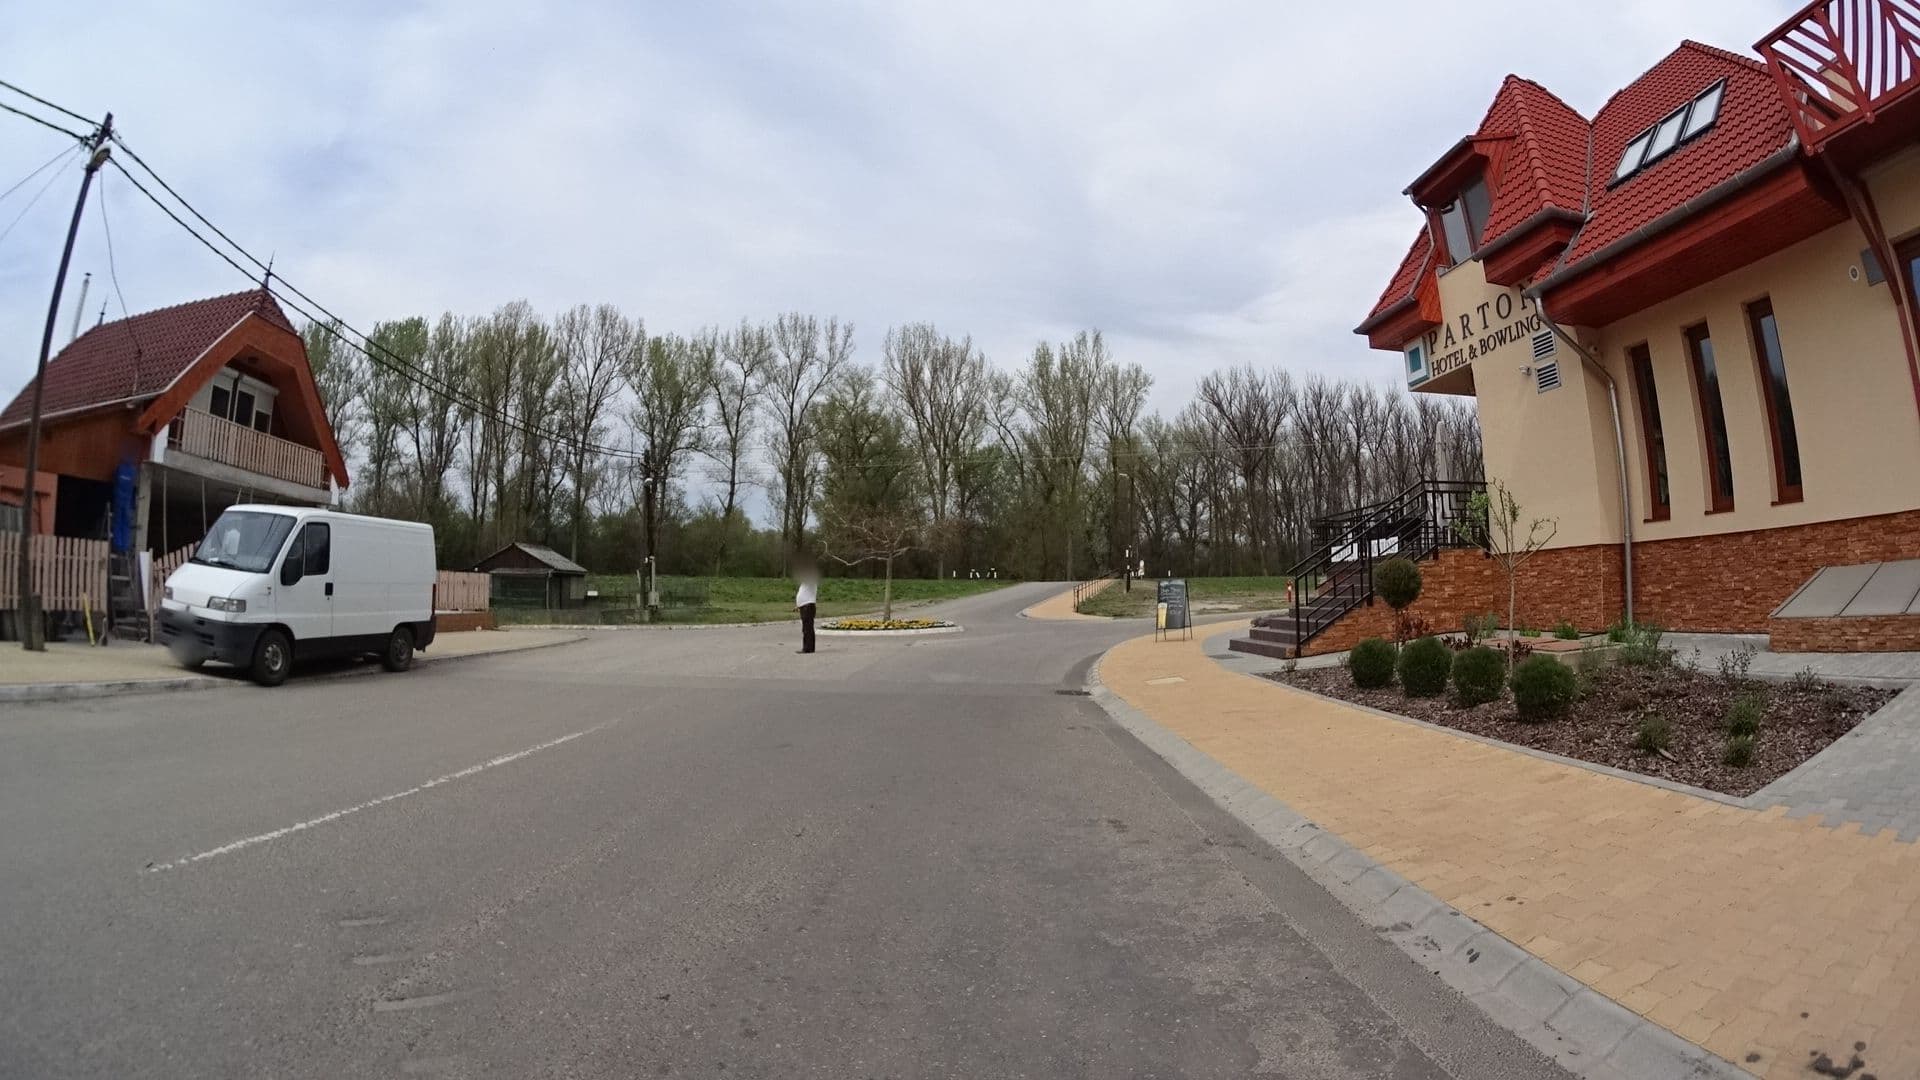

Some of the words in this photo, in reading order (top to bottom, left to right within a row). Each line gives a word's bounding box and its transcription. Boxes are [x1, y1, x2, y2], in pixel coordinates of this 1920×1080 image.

[1431, 348, 1467, 377] HOTEL
[1468, 343, 1478, 360] &
[1479, 313, 1541, 356] BOWLING
